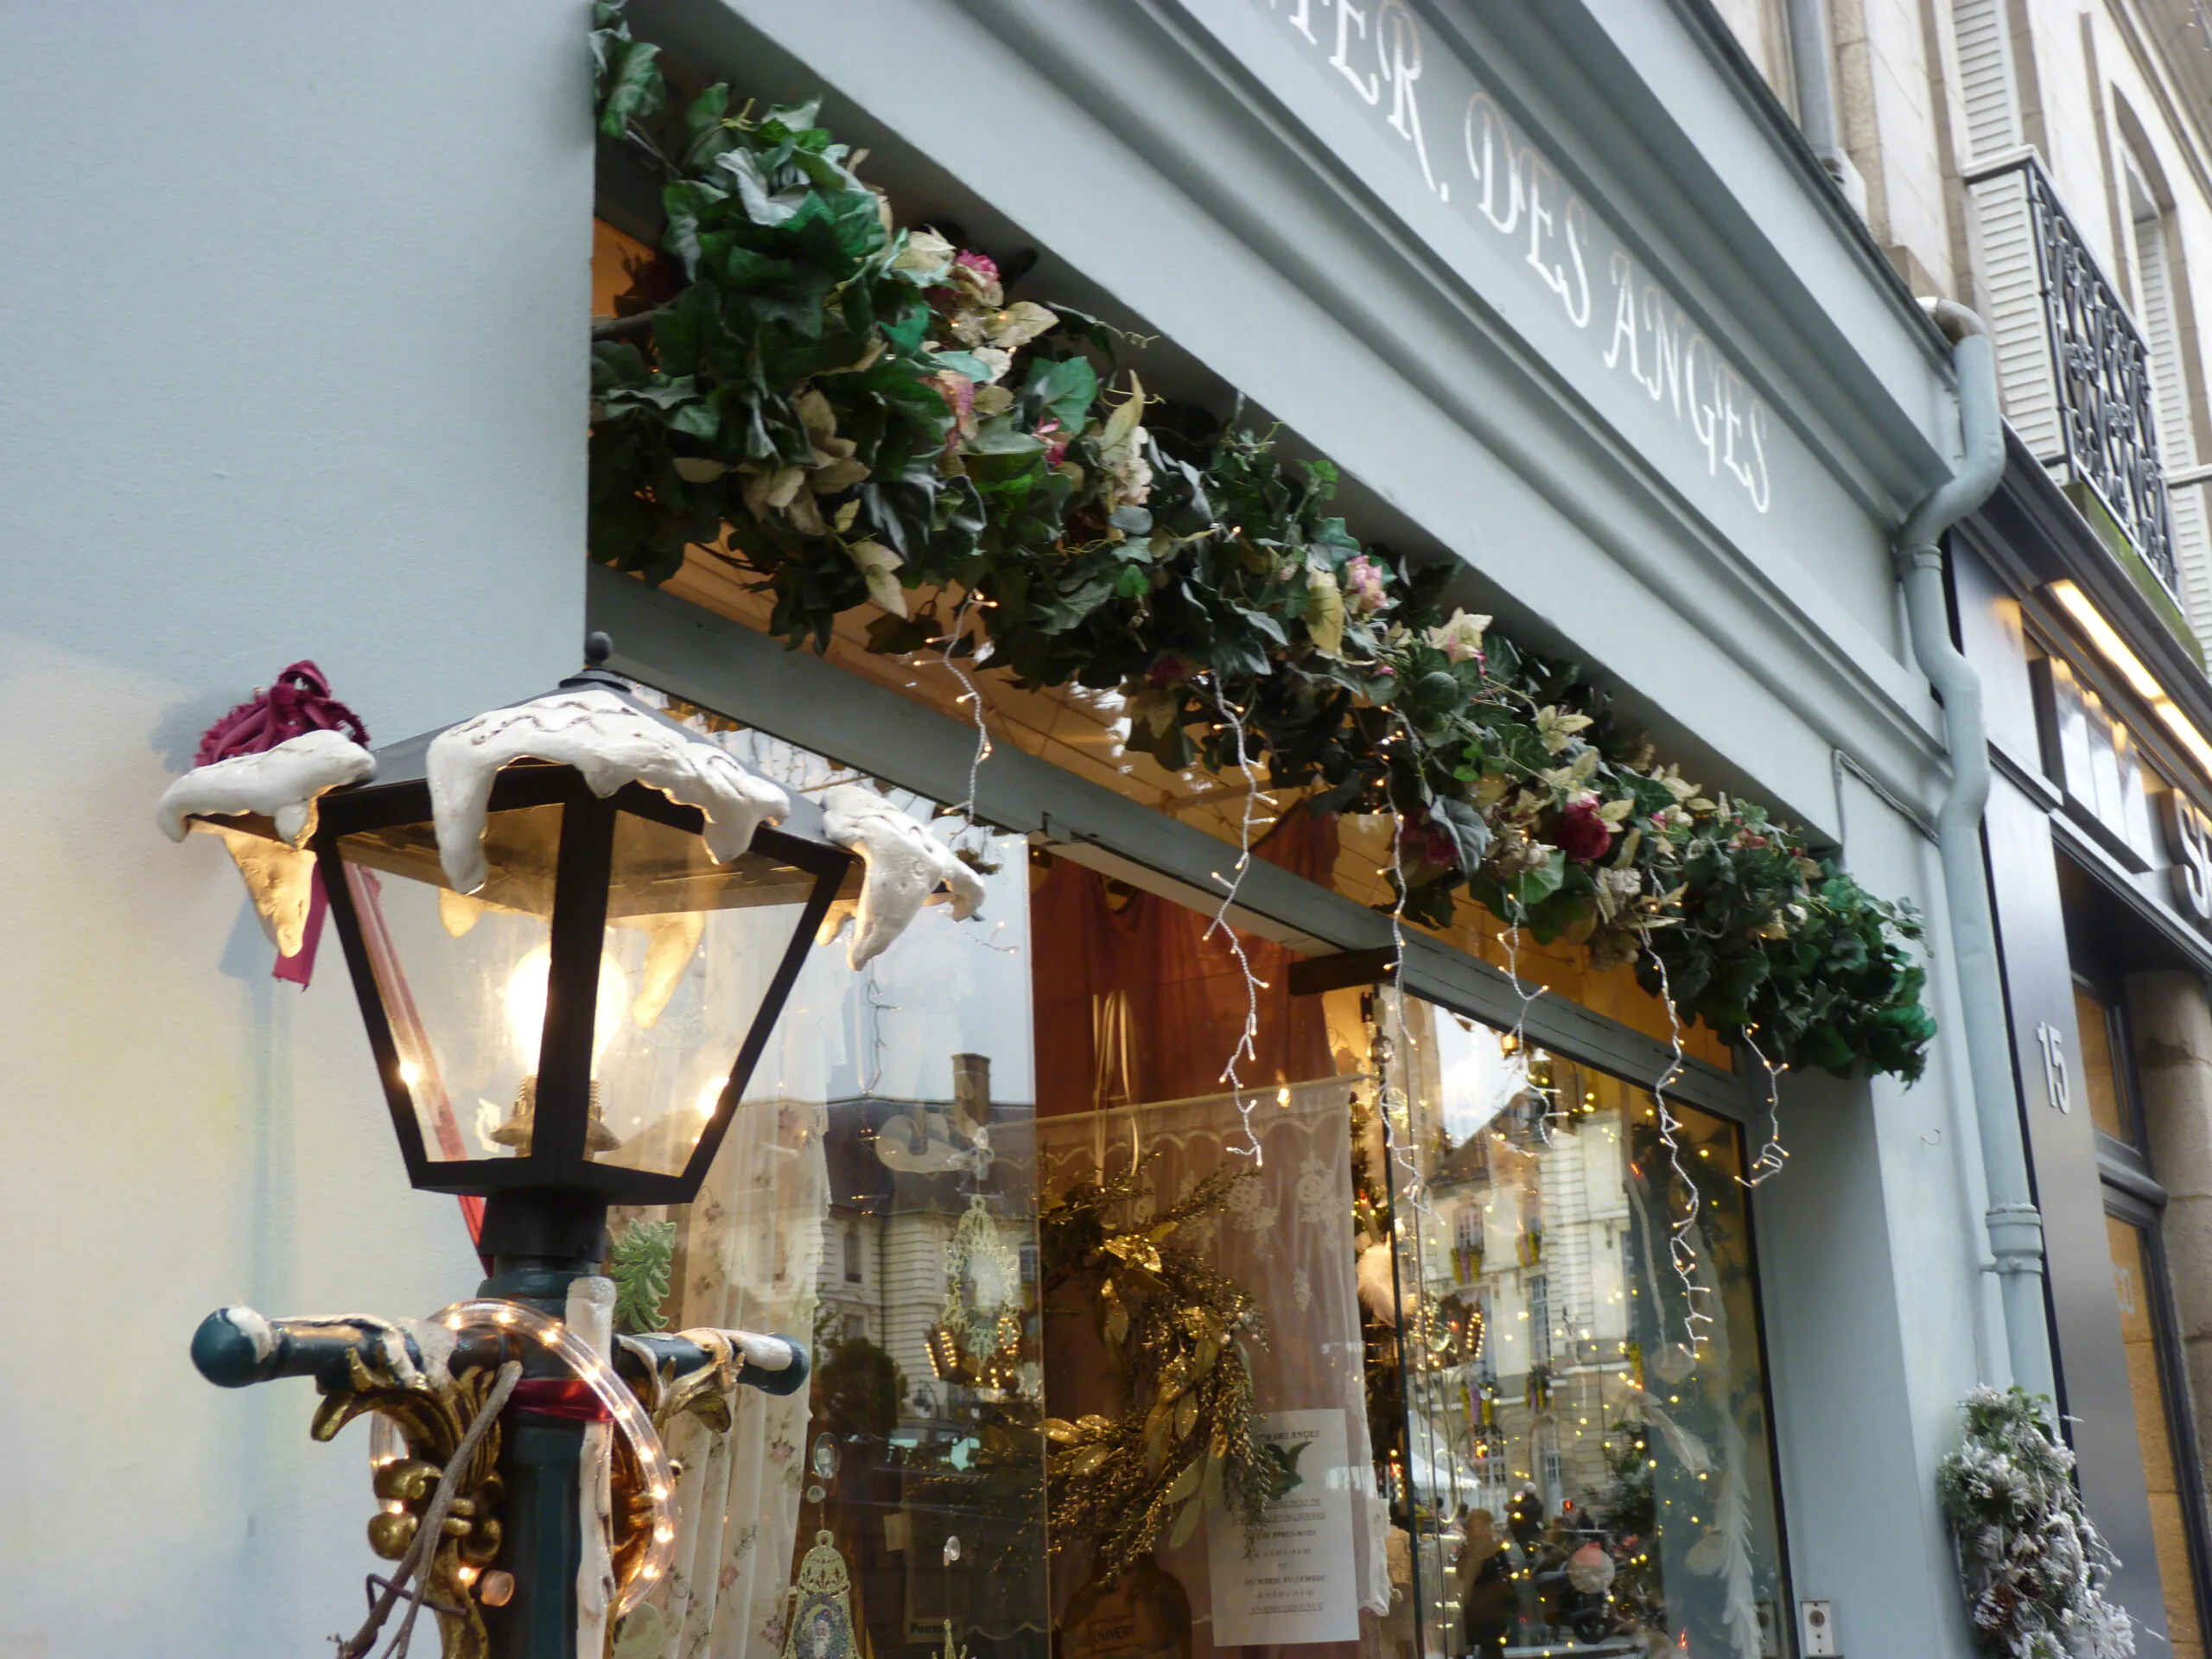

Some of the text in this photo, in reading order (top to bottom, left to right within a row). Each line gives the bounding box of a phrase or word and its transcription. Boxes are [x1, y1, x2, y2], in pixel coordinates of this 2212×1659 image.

[1464, 92, 1592, 329] DES
[1602, 251, 1770, 513] ANGES
[2036, 1021, 2071, 1115] 15
